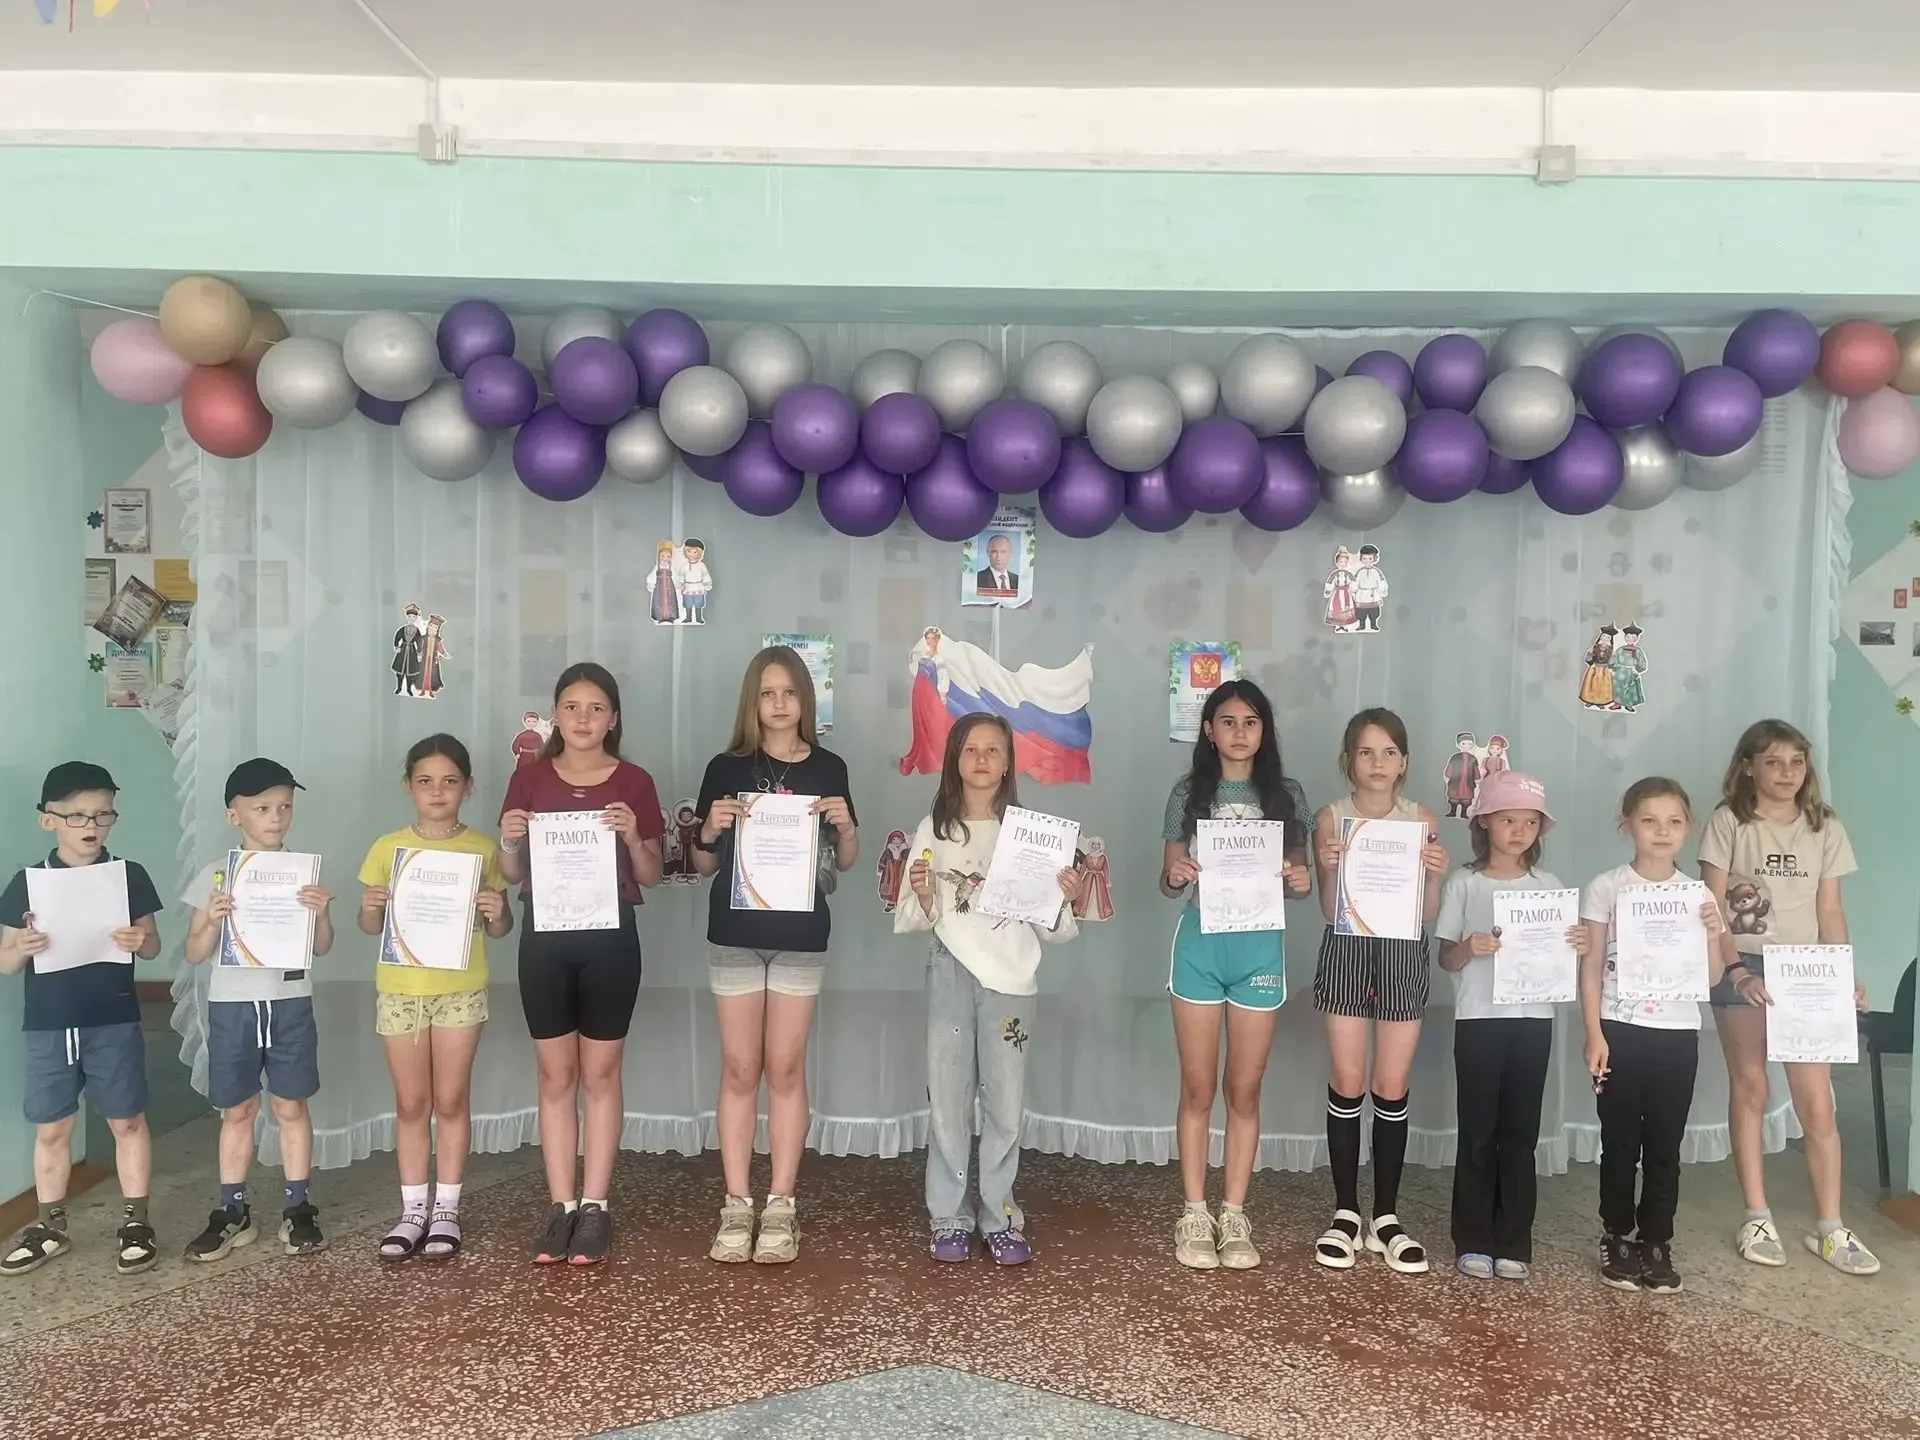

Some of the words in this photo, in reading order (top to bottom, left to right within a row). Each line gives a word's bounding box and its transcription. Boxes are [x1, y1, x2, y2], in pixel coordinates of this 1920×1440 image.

[545, 830, 599, 845] ГРАМОТА
[1013, 826, 1063, 851] ГРАМОТА
[1212, 835, 1266, 850] ГРАМОТА
[1509, 908, 1562, 923] ГРАМОТА
[1632, 901, 1688, 916] ГРАМОТА
[1780, 963, 1837, 977] ГРАМОТА
